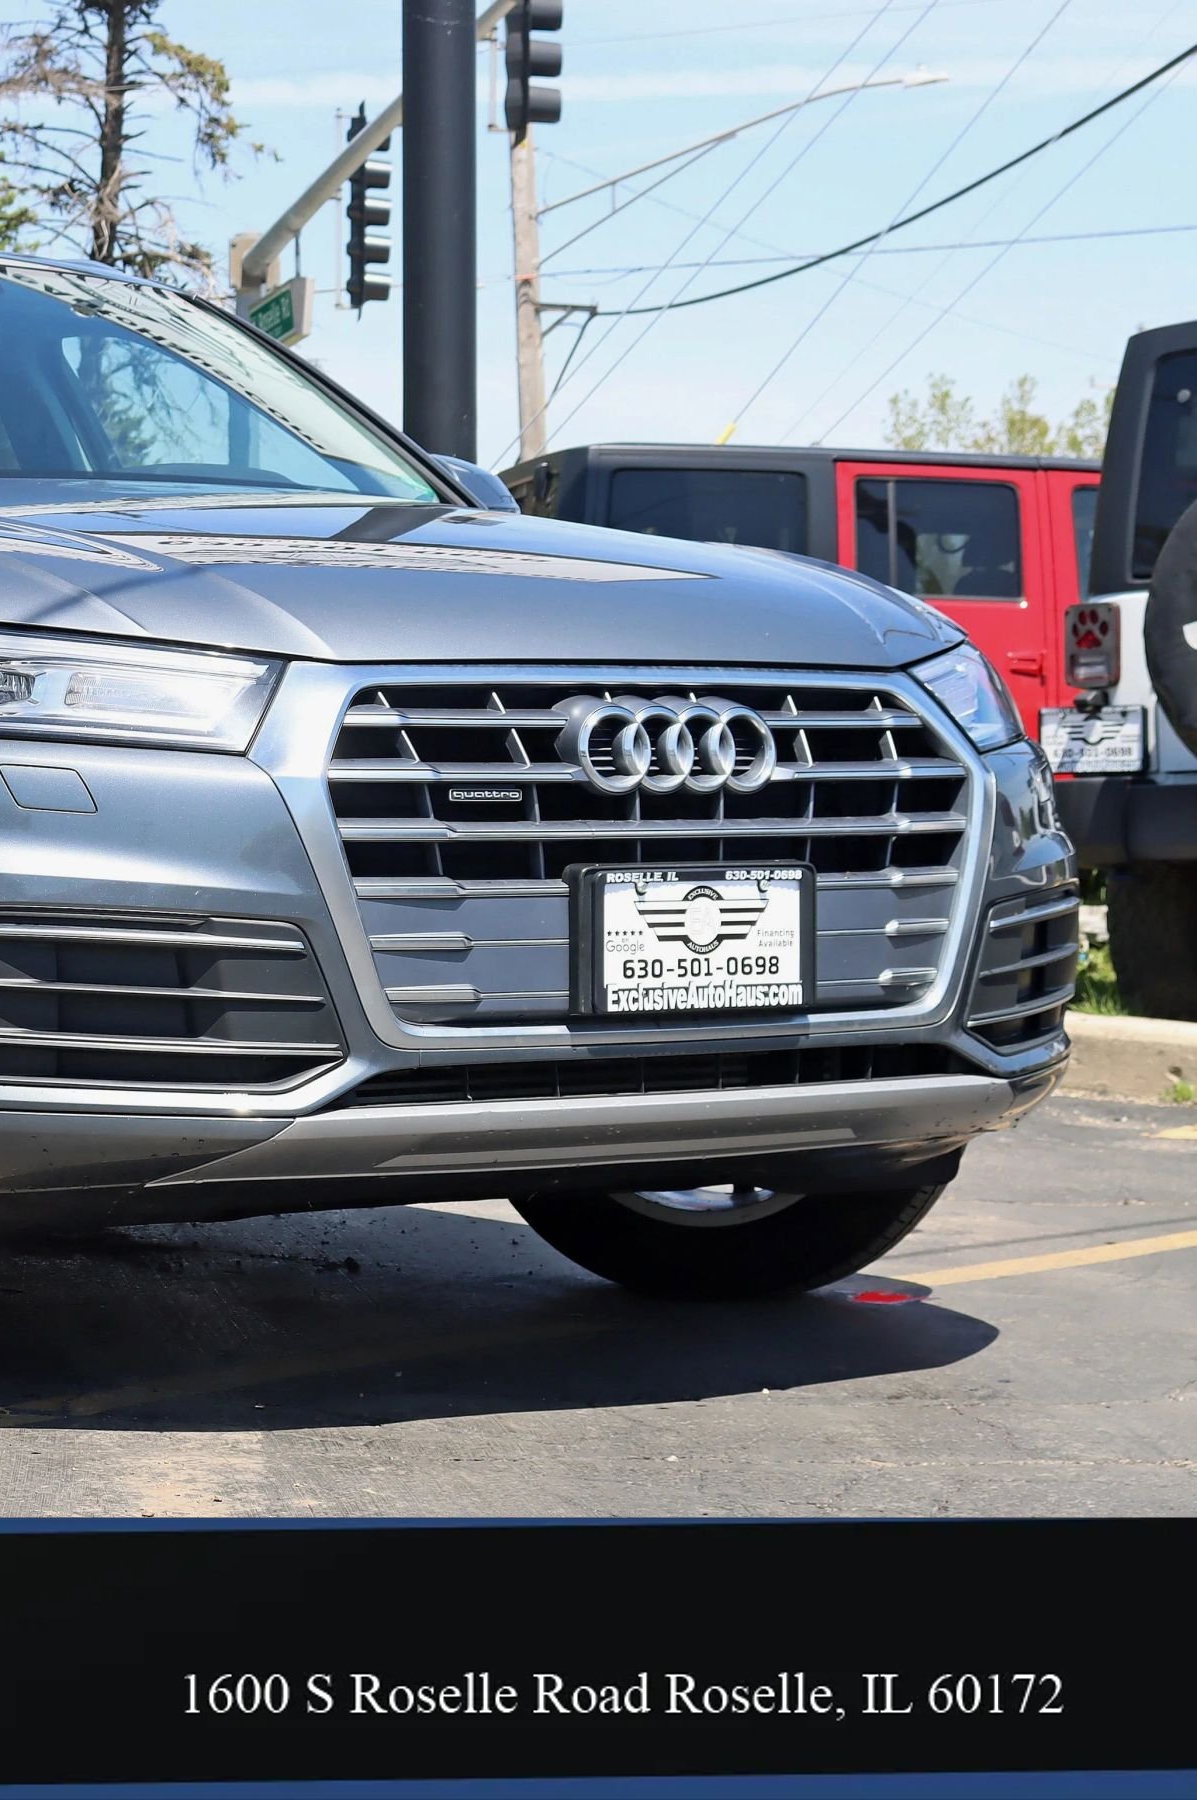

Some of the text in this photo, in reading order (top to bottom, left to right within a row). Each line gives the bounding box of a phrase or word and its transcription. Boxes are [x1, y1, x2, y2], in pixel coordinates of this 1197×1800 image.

[453, 790, 520, 799] quattro
[667, 871, 679, 882] IL
[725, 869, 803, 881] 630-501-0698
[687, 888, 719, 901] EXCLUSIVE
[757, 929, 795, 939] Financing
[606, 940, 645, 955] Google
[687, 939, 720, 954] AUTOHAUS
[758, 939, 794, 947] Available
[622, 956, 780, 979] 630-501-0698
[606, 981, 803, 1013] ExclusiveAutoHaus.com
